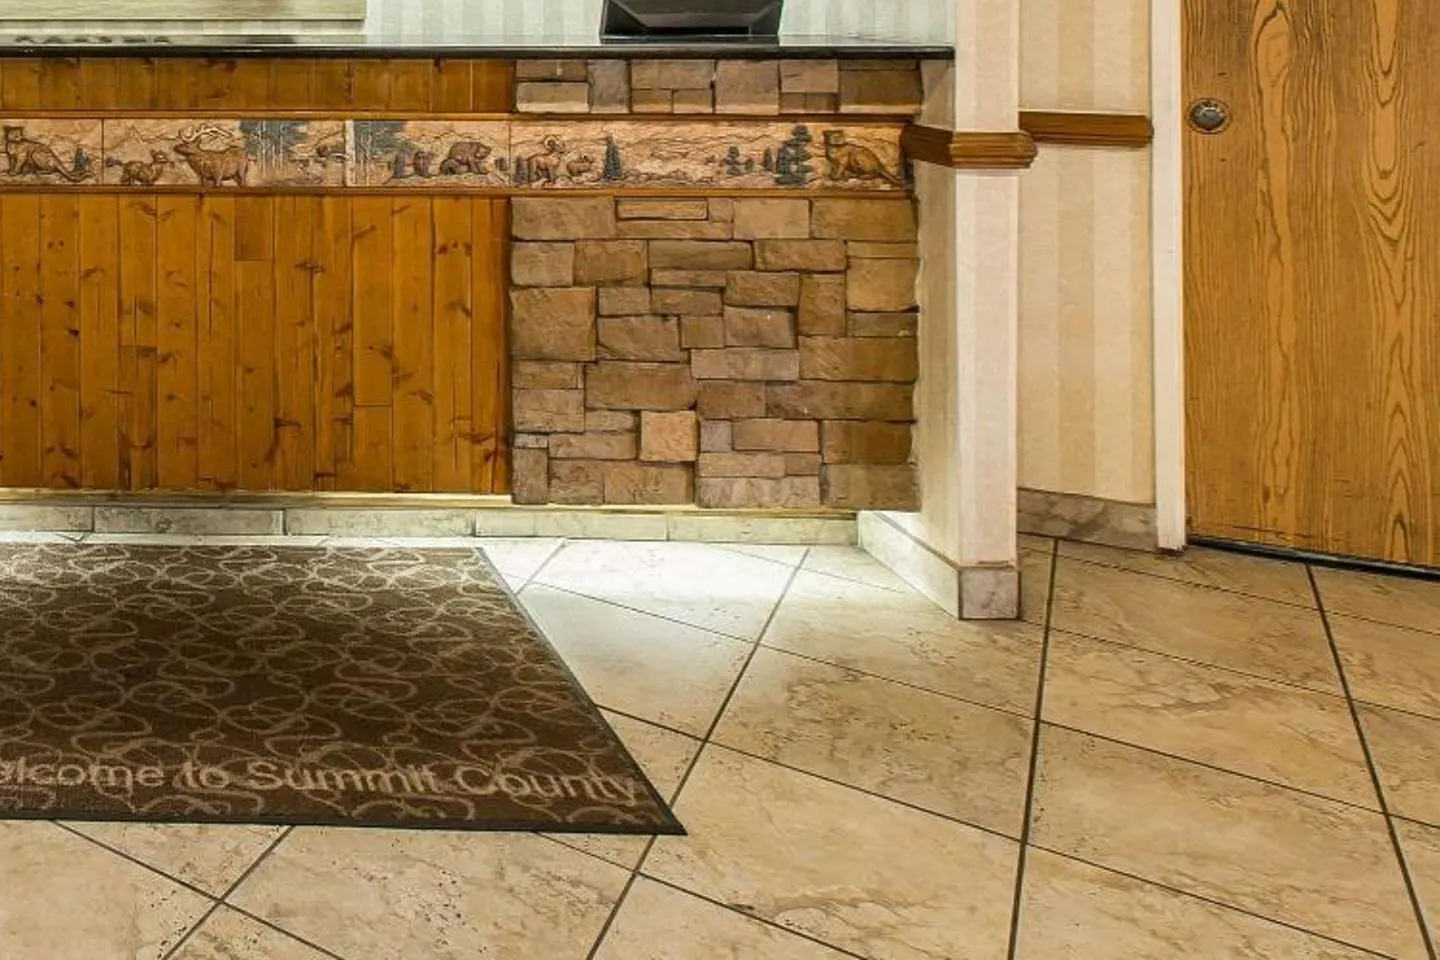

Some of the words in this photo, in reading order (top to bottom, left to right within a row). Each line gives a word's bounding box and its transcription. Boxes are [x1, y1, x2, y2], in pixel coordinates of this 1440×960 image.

[181, 760, 229, 789] to
[248, 761, 438, 794] Summit
[457, 764, 636, 807] County
